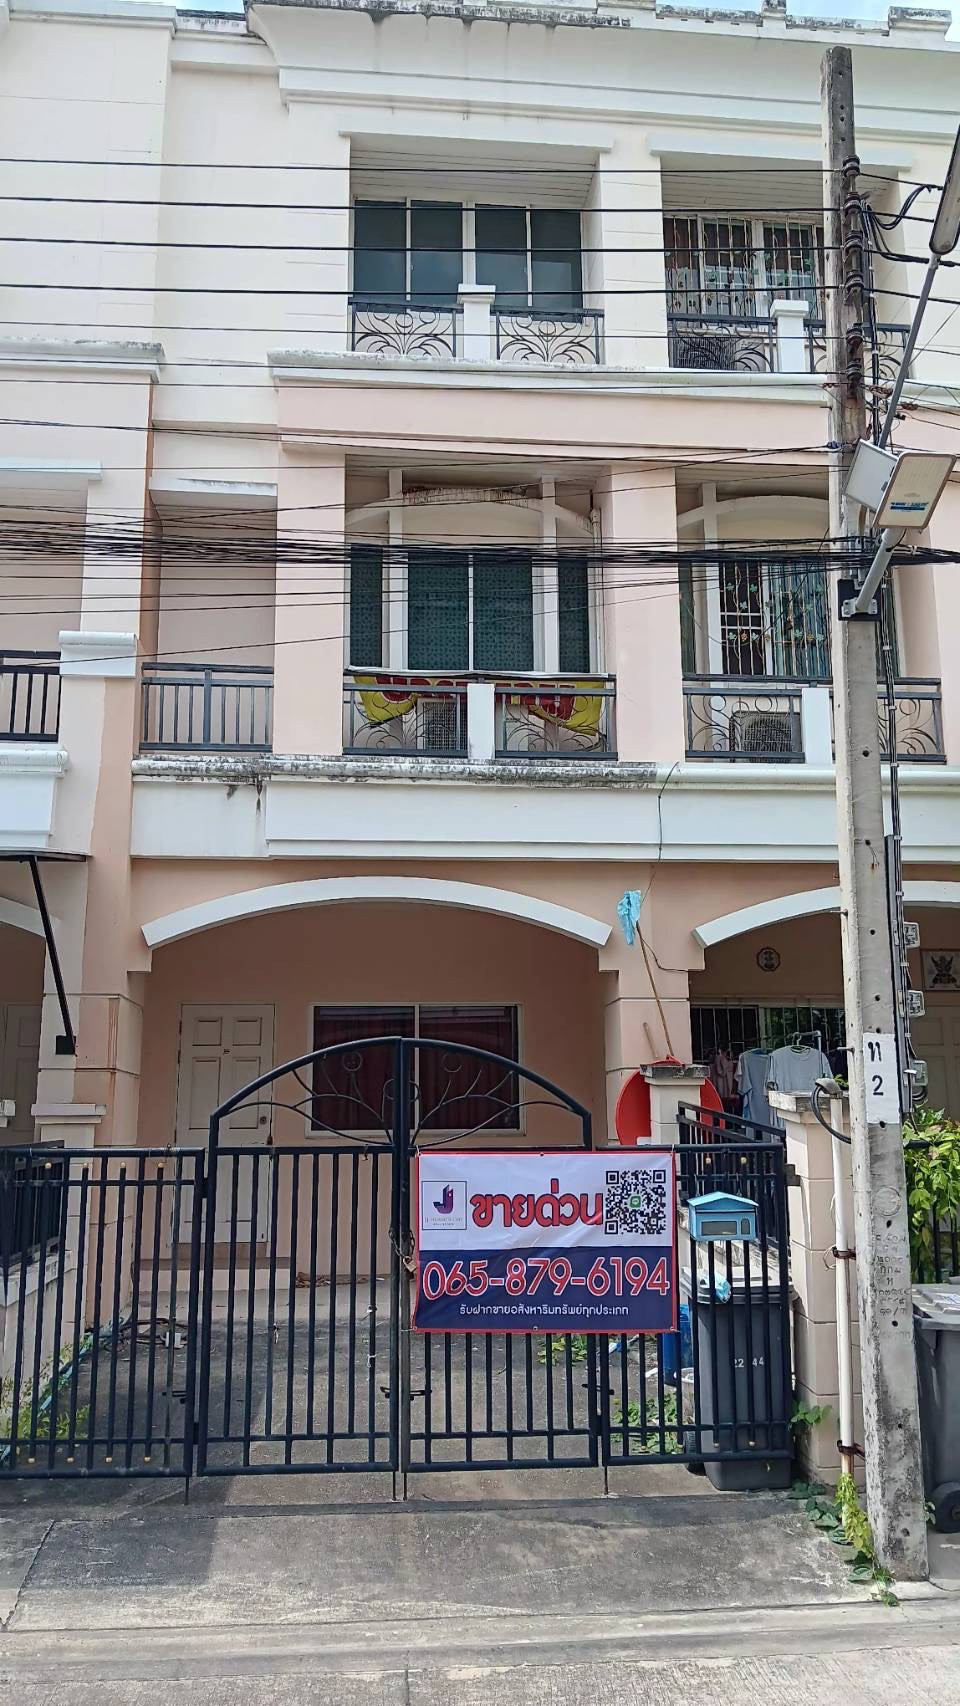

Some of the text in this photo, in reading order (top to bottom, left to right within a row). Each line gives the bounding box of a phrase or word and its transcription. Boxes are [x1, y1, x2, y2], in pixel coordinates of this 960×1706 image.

[872, 1074, 884, 1096] 2
[470, 1178, 604, 1228] ขายด่วน
[423, 1256, 670, 1301] 065-879-6194
[459, 1303, 629, 1318] รับฝากขายอสังหาริมทรัพย์ทุกประเภท
